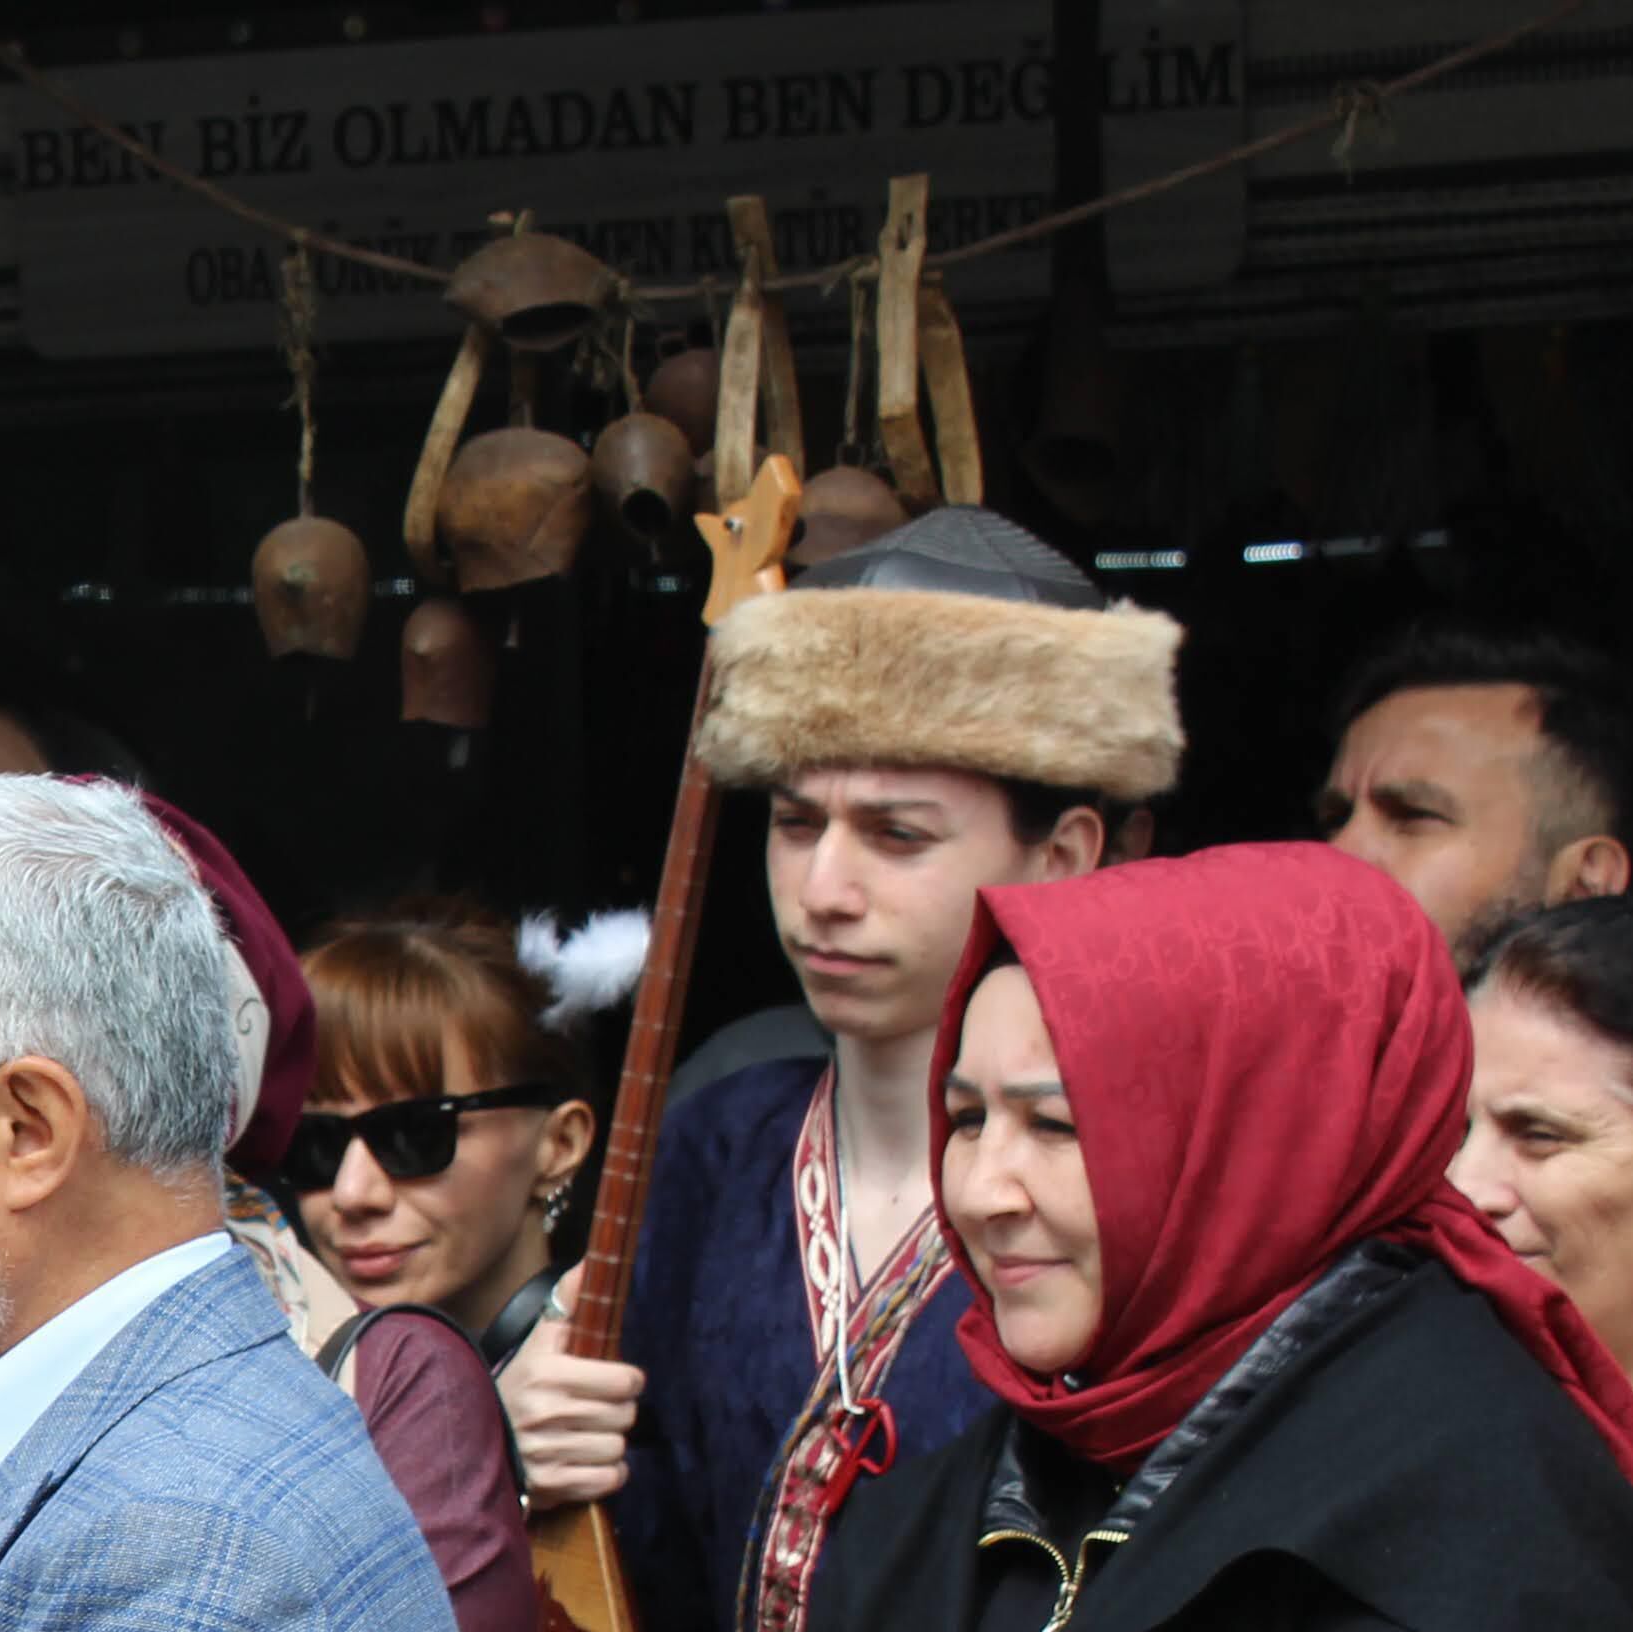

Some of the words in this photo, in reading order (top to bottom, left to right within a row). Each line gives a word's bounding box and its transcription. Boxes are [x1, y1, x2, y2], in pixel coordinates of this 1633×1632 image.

[194, 94, 313, 180] BİZ
[333, 82, 697, 170] OLMADAN
[723, 67, 880, 144] BEN
[902, 27, 1239, 129] DEĞLİM
[185, 244, 277, 308] OBA
[284, 217, 449, 298] ÖRÜK
